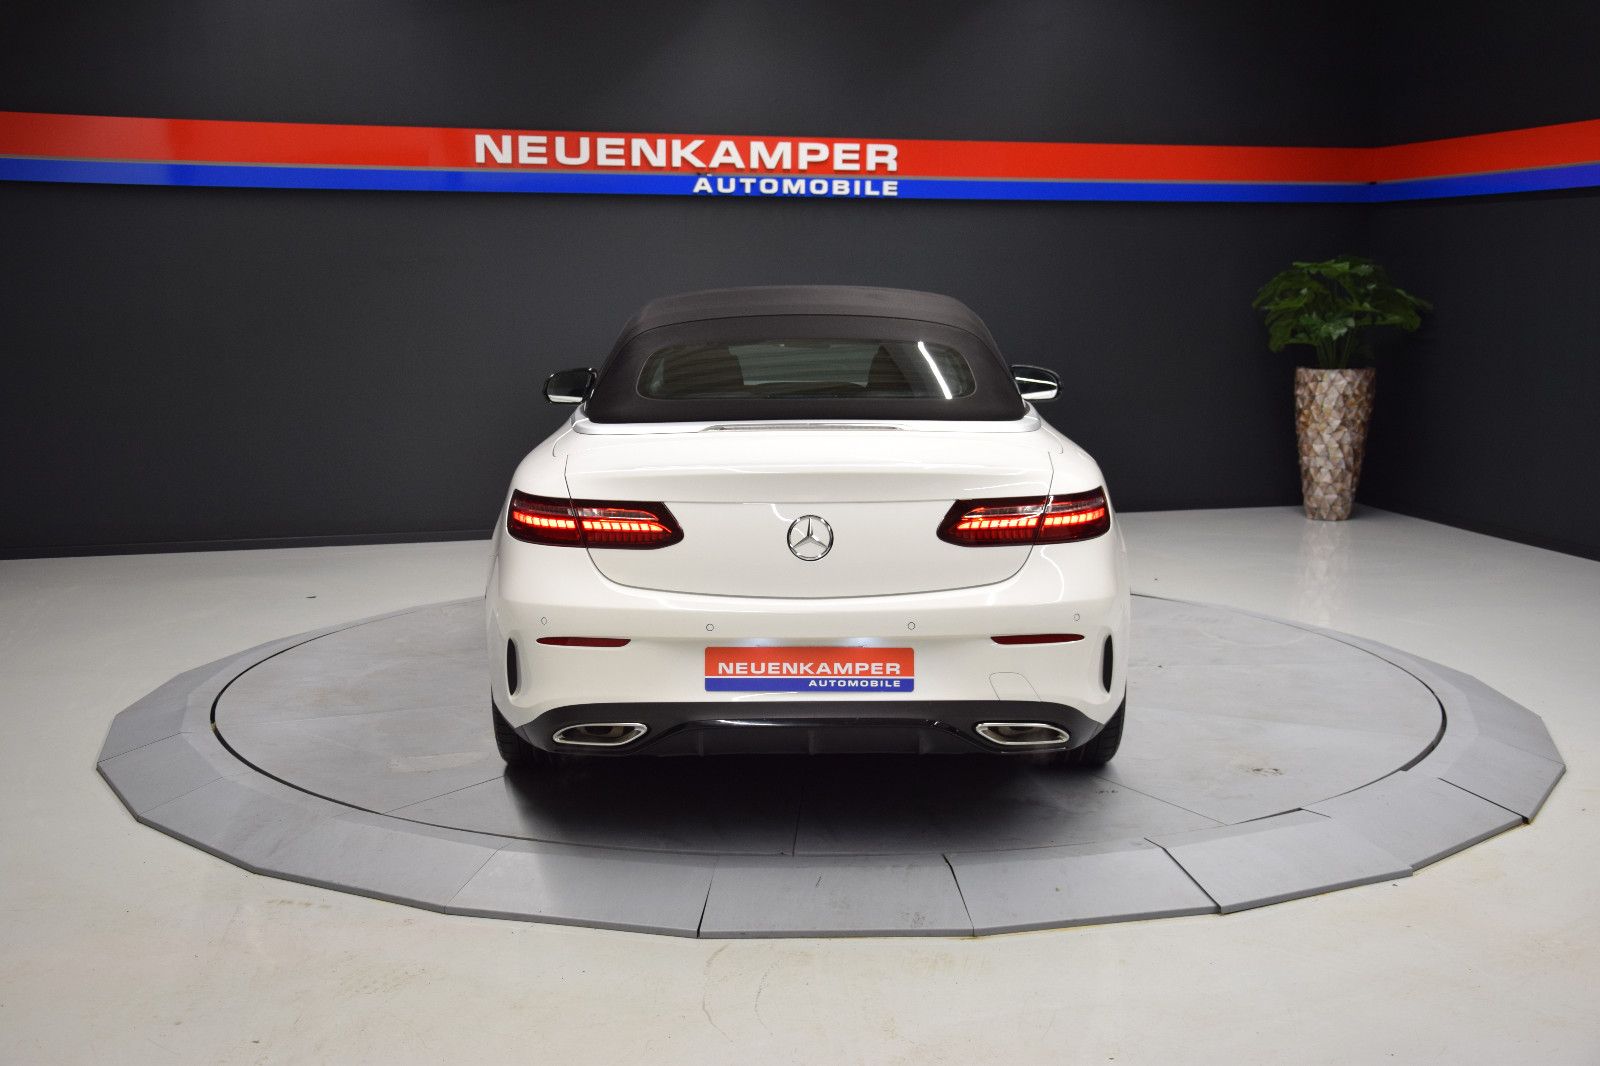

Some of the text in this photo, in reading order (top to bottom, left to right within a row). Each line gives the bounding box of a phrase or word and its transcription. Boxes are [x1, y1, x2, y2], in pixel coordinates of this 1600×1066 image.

[474, 134, 898, 172] NEUENKAMPER
[693, 177, 898, 196] AUTOMOBILE
[717, 662, 901, 676] NEUENKAMPER
[808, 679, 901, 688] AUTOMOBILE
